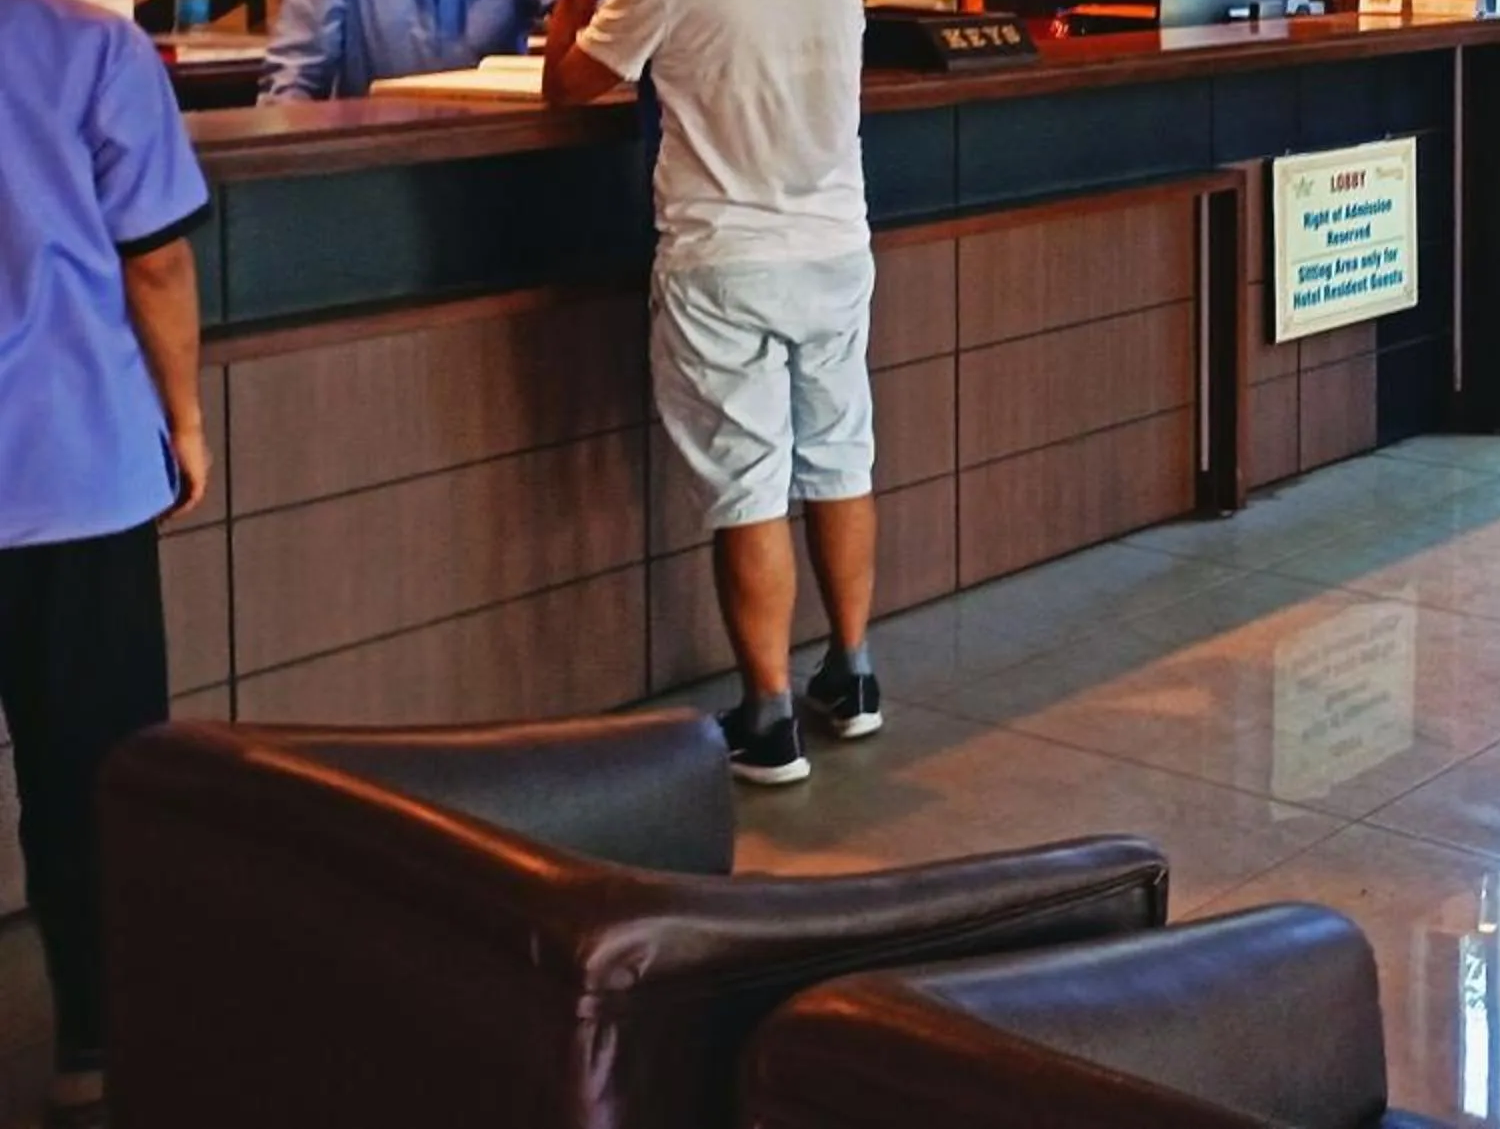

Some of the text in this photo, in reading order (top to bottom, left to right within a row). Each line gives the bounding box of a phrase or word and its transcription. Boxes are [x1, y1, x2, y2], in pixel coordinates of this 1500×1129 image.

[941, 24, 1021, 49] KEYS
[1330, 171, 1366, 193] LOBBY
[1303, 198, 1392, 230] Right of Admission
[1327, 223, 1371, 245] Reserved
[1298, 246, 1399, 284] Sitting Area only for
[1293, 268, 1403, 310] Hotel Resident Guests
